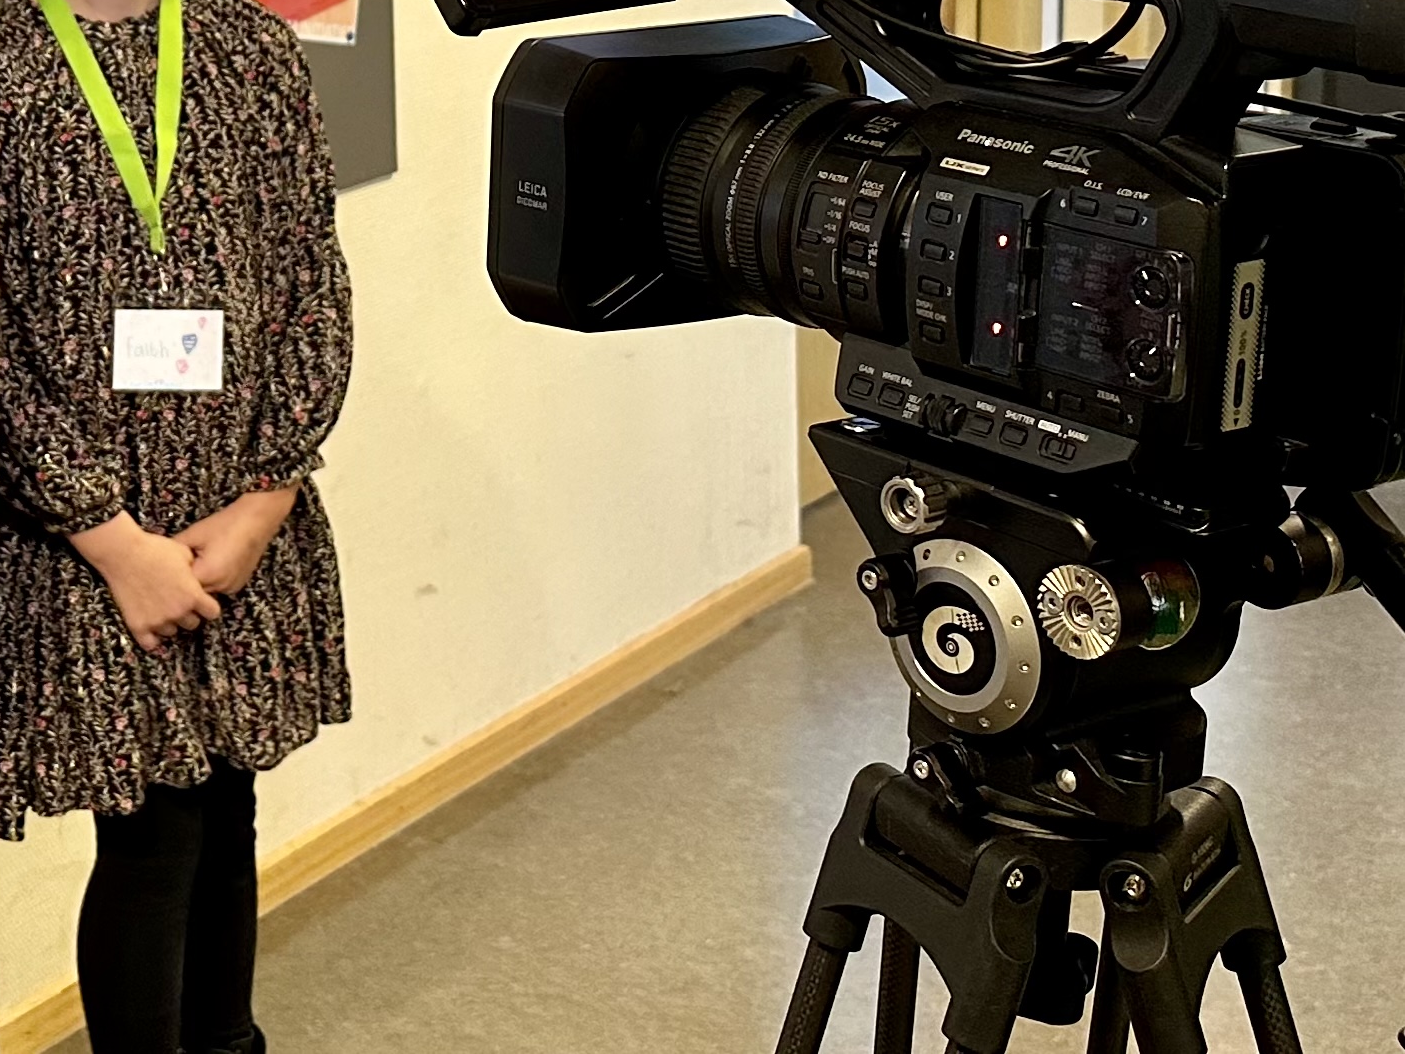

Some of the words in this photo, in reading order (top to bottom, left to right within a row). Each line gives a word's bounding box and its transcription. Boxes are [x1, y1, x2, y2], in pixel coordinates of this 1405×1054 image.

[957, 129, 1035, 155] Panasonic
[1049, 146, 1101, 168] 4K
[518, 180, 548, 198] LEICA
[861, 180, 884, 191] FOCUS
[935, 191, 954, 202] USER
[1060, 198, 1066, 208] 6
[956, 213, 962, 223] 1
[1142, 216, 1148, 225] 7
[848, 221, 870, 234] FOCUS
[949, 250, 955, 260] 2
[946, 286, 952, 297] 3
[858, 364, 875, 375] GAIN
[1047, 390, 1053, 400] 4
[1097, 389, 1121, 404] ZEBRA
[975, 400, 996, 413] MENU
[1004, 409, 1036, 426] SHUTTER
[1127, 414, 1133, 425] 5
